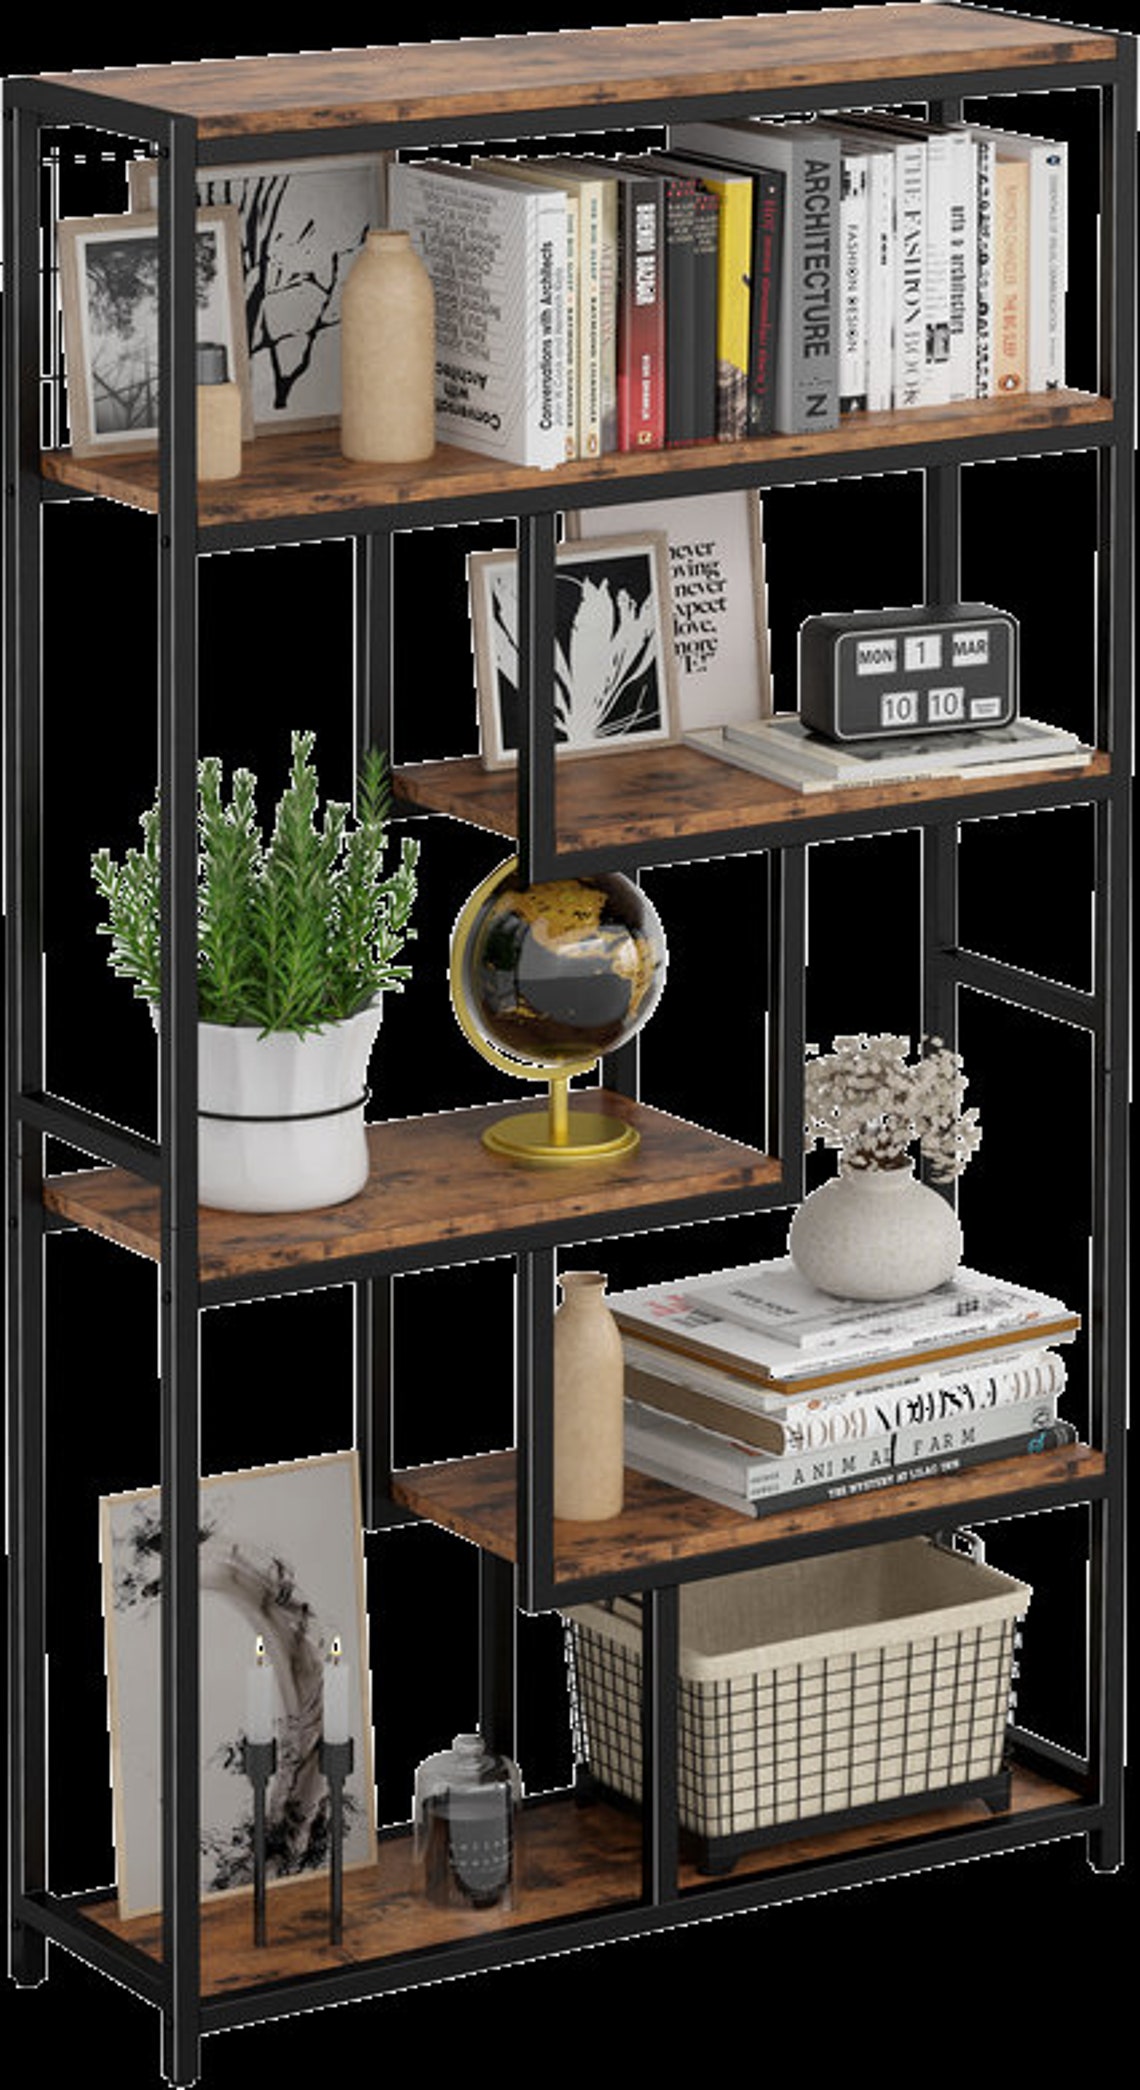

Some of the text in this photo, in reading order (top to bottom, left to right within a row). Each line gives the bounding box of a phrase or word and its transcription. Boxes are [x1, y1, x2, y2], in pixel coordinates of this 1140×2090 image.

[803, 159, 831, 359] ARCHITECTURE
[903, 154, 922, 404] THE FASHION BOOK
[847, 224, 859, 352] FASHION DESIGN
[950, 253, 967, 335] architecture
[539, 241, 553, 430] Conversations with Architects
[434, 361, 488, 391] Architec
[435, 399, 501, 432] Conversat
[672, 597, 727, 621] xpect
[675, 579, 727, 598] never
[858, 639, 987, 664] MON 1 MAR
[886, 696, 910, 720] 10
[932, 692, 959, 716] 10
[876, 1377, 997, 1431] FASHION
[792, 1426, 976, 1487] ANIMAL FARM
